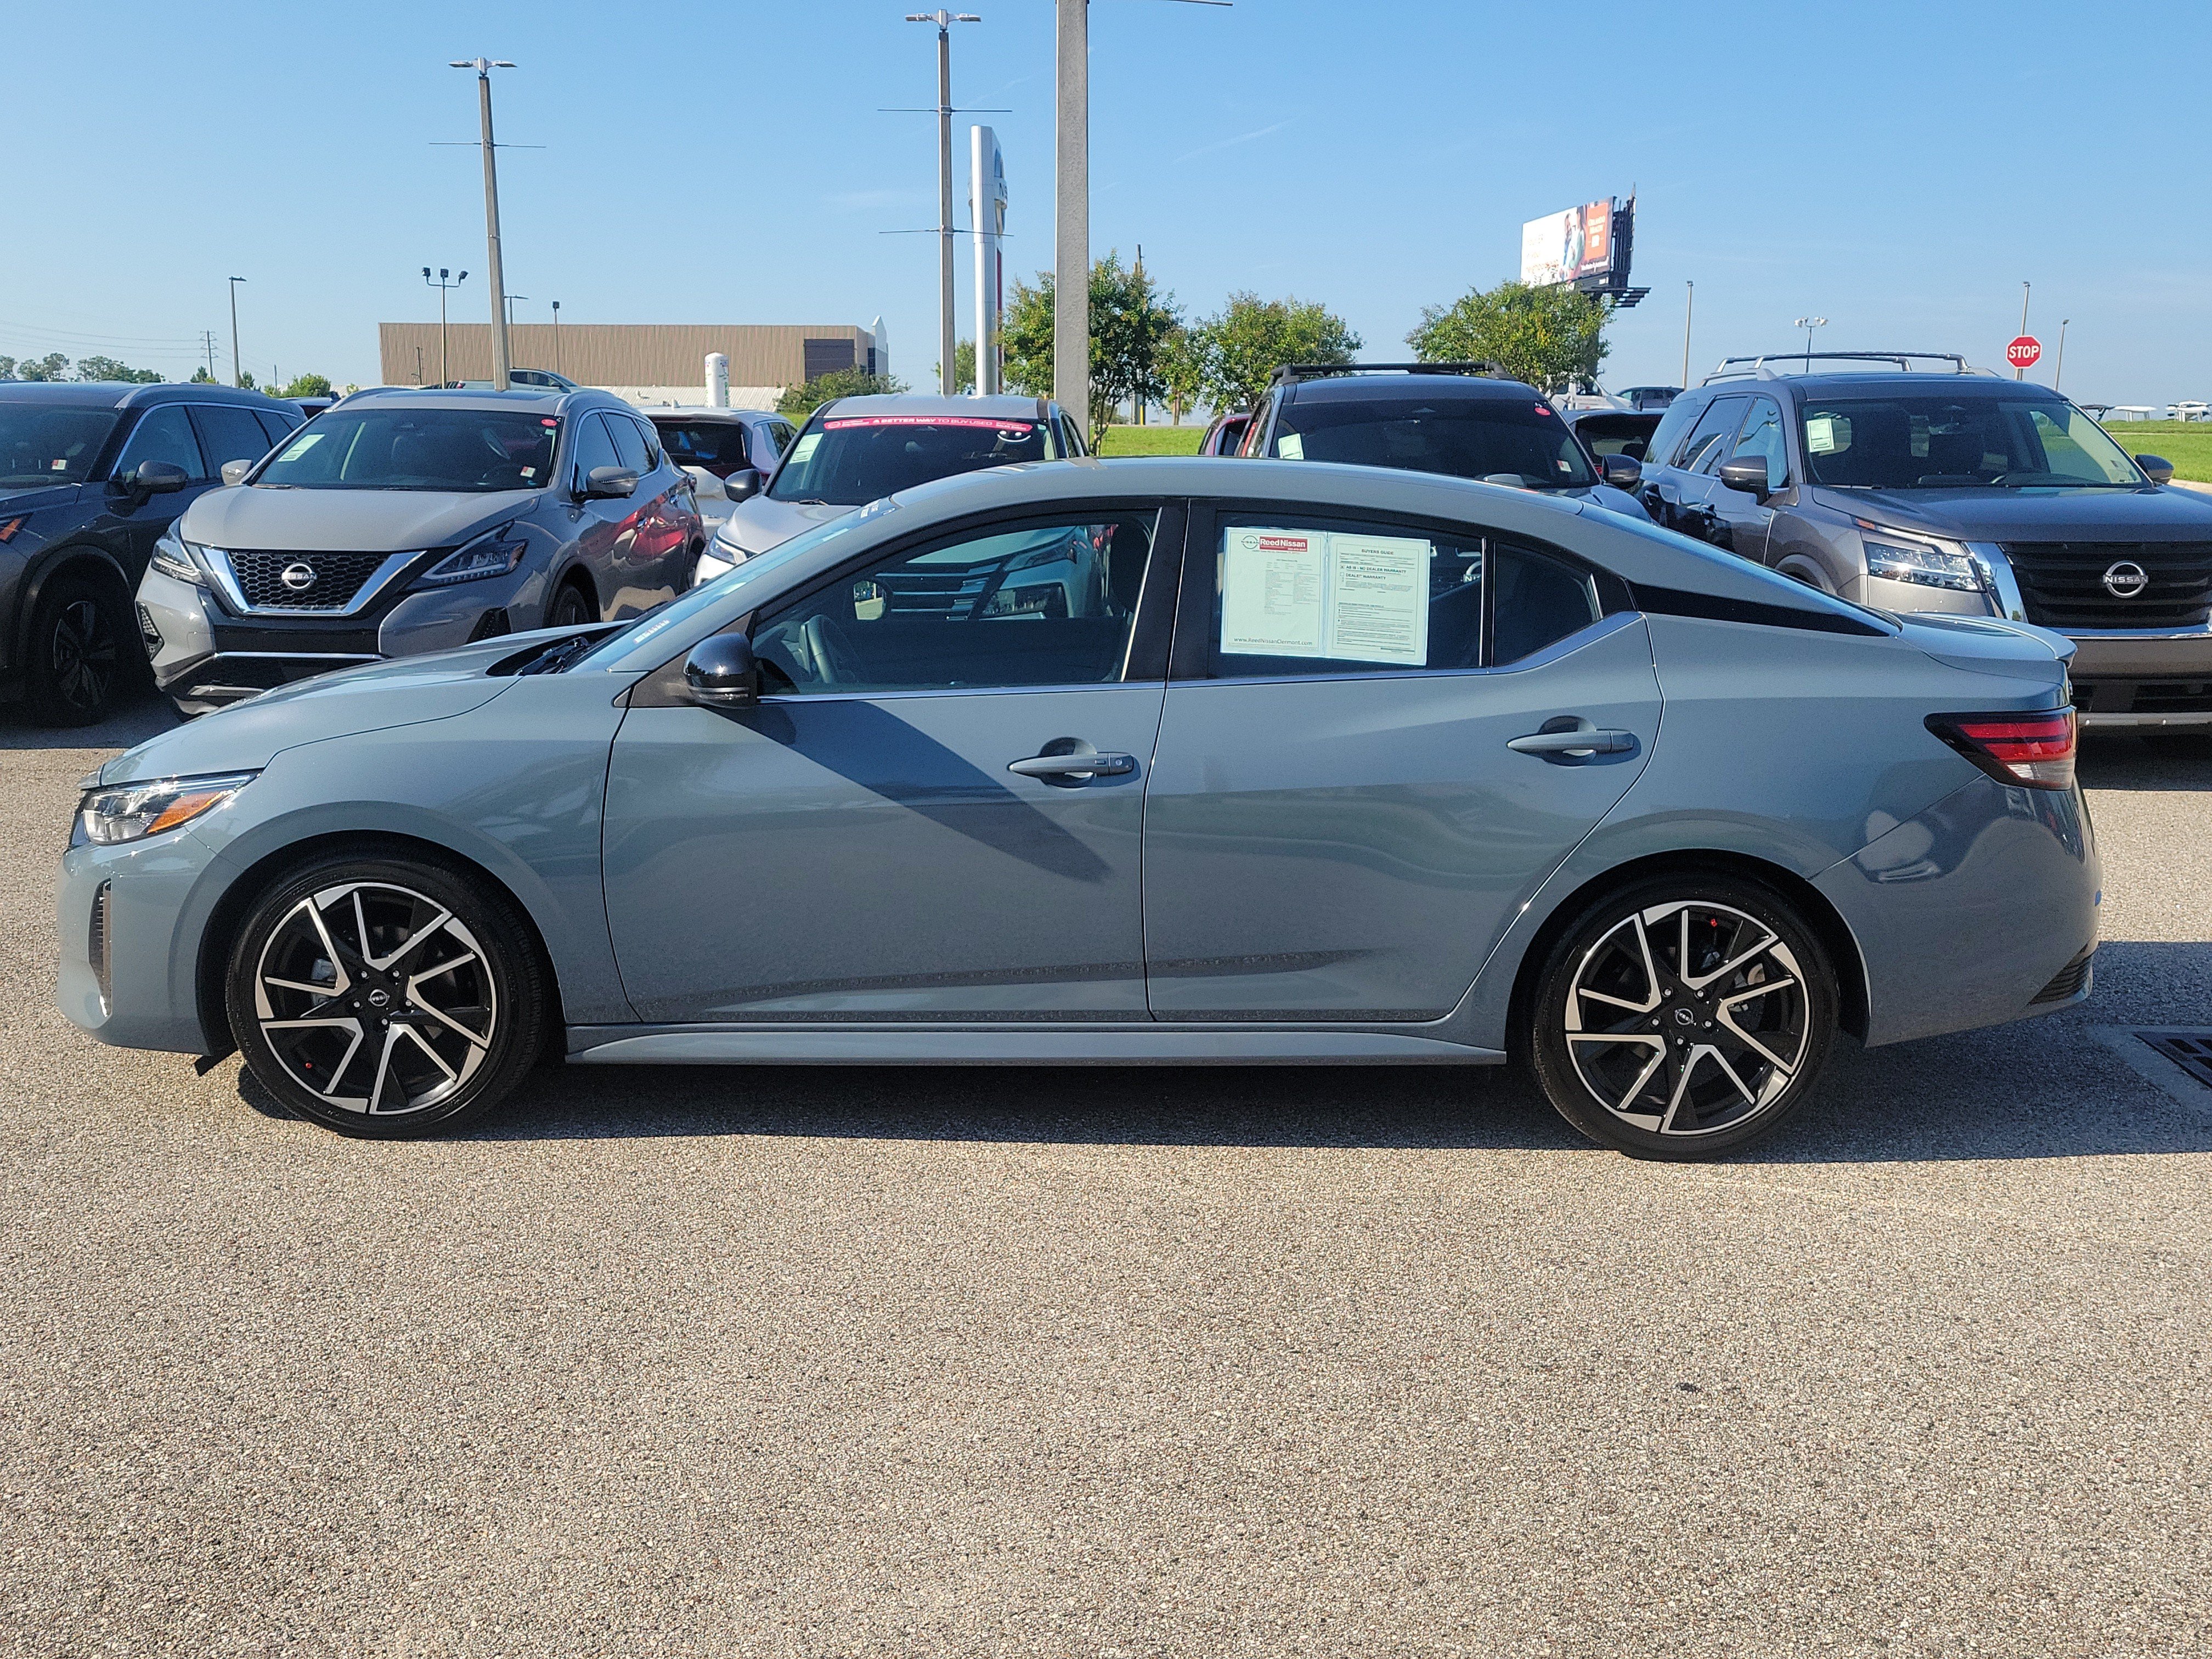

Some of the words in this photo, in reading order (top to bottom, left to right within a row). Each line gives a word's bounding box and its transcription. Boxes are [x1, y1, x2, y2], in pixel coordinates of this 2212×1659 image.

[2008, 345, 2039, 359] STOP
[1280, 539, 1305, 548] Nissan
[1234, 637, 1313, 646] www.ReedNissanClermont.com
